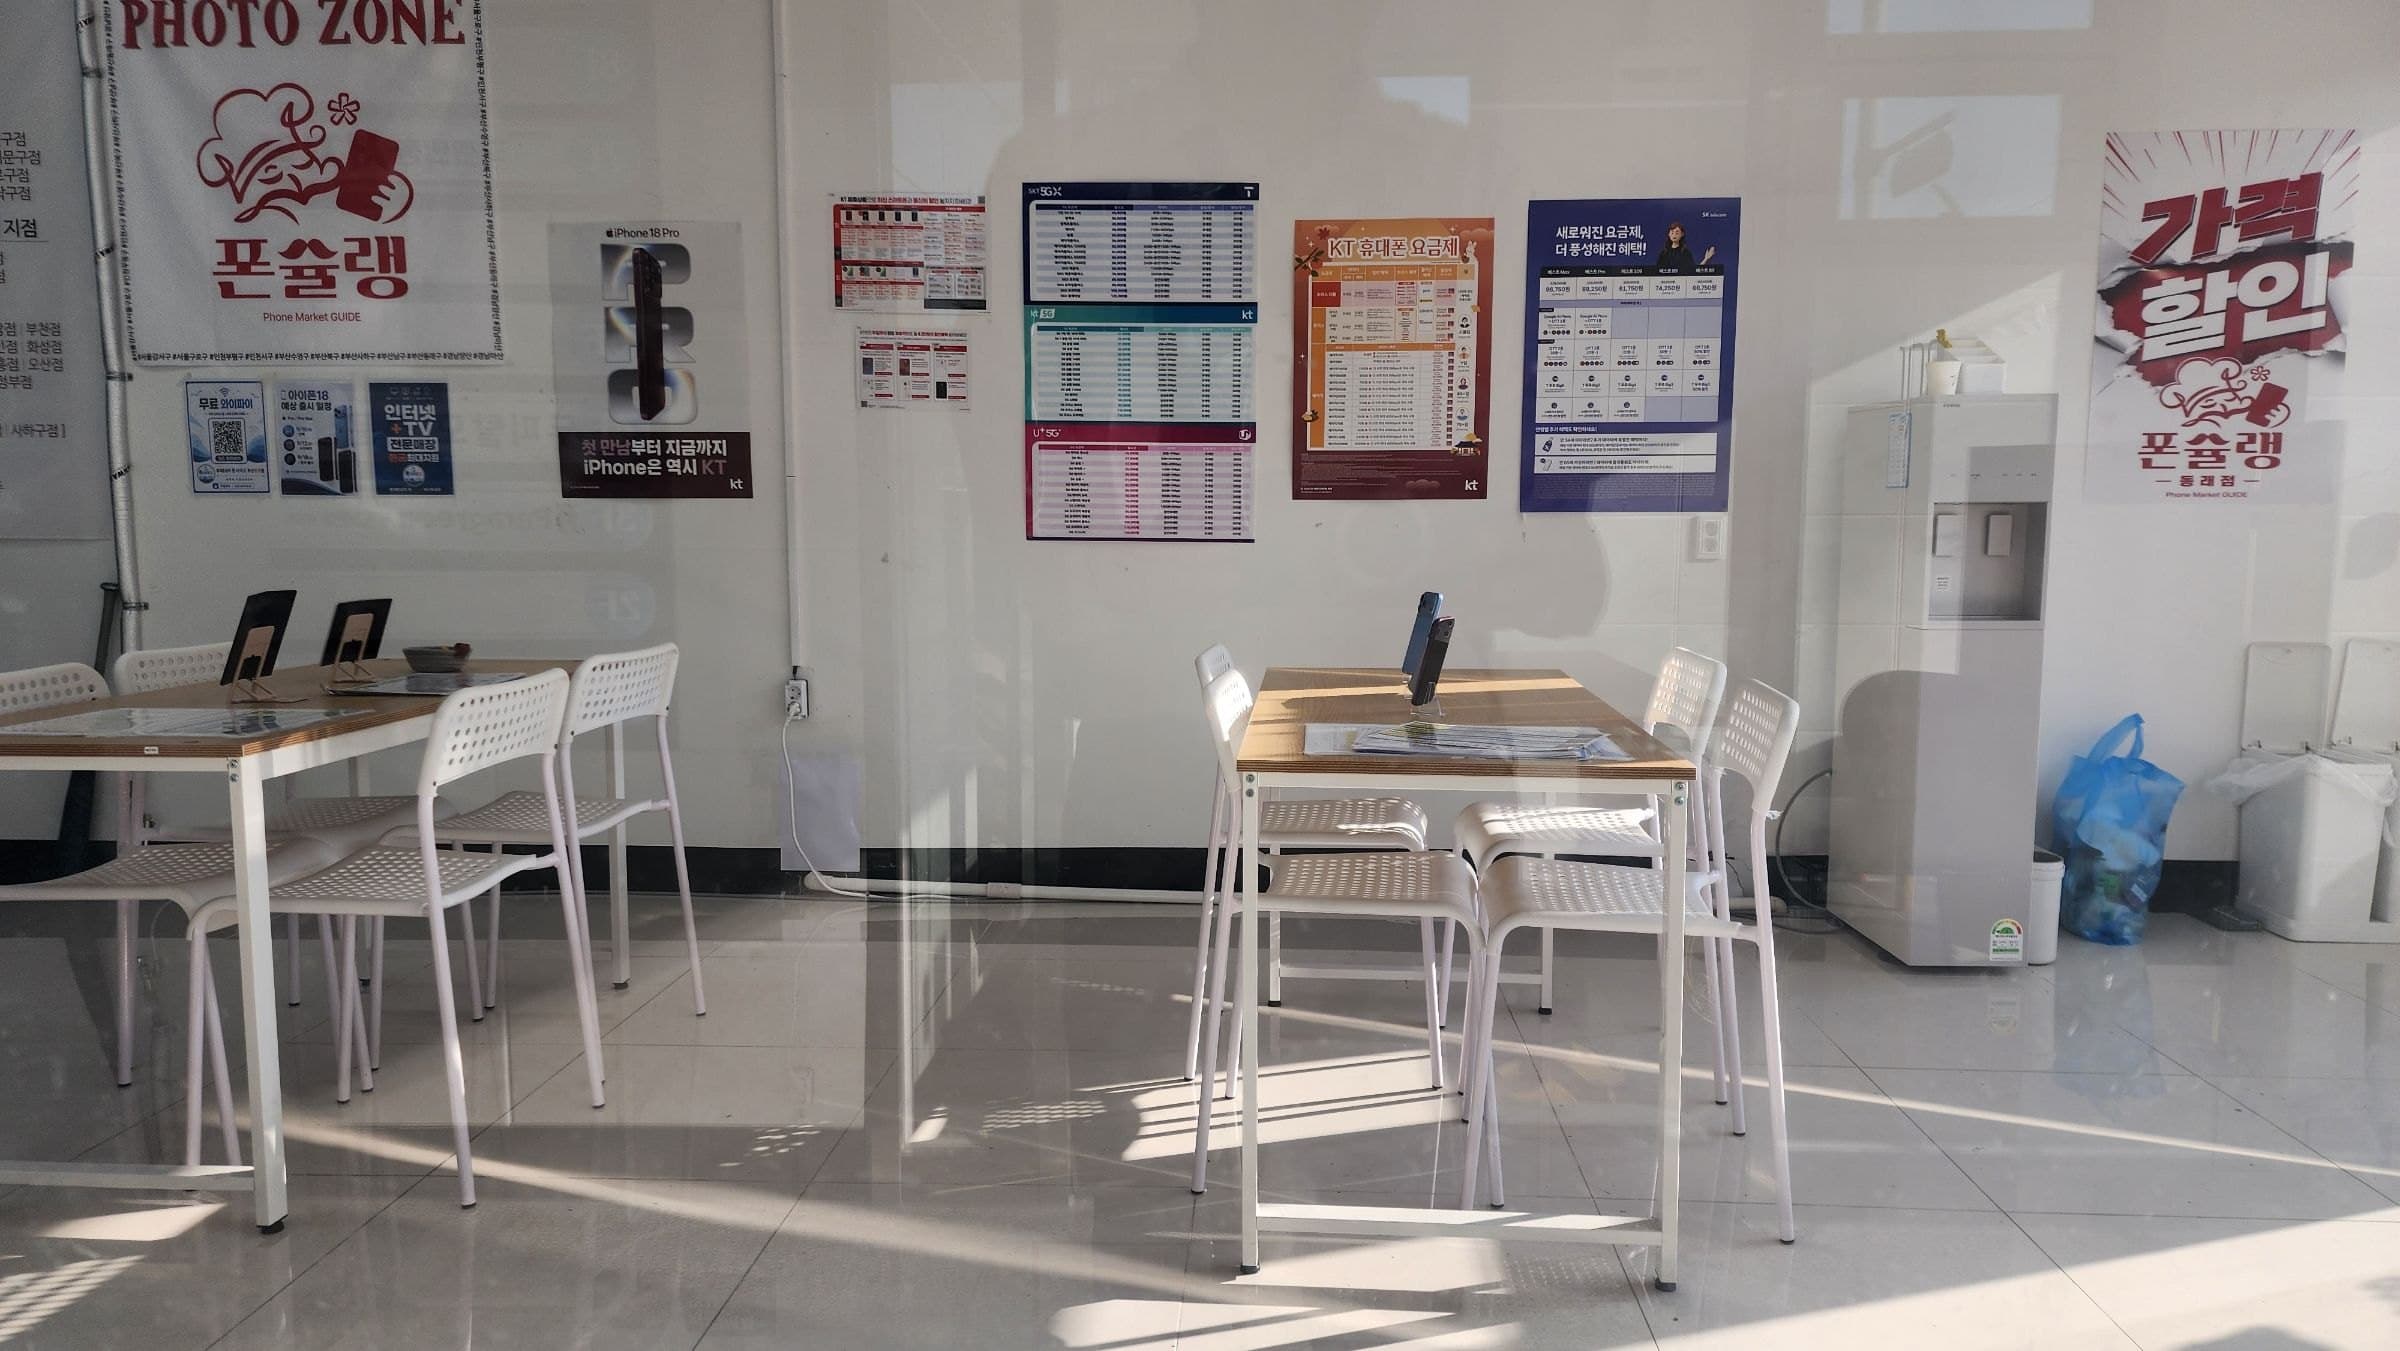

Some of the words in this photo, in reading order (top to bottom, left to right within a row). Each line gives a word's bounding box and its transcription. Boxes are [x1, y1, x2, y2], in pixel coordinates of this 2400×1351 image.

[121, 0, 300, 49] PHOTO
[318, 0, 466, 46] ZONE
[0, 150, 41, 165] 문구점
[0, 168, 29, 183] 구점
[2130, 171, 2324, 264] 가격
[3, 218, 37, 238] 지점
[614, 228, 649, 238] iPhone
[650, 228, 661, 238] 18
[662, 228, 680, 238] Pro
[1556, 225, 1604, 240] 새로워진
[1604, 225, 1644, 240] 요금제,
[1330, 239, 1356, 257] KT
[1359, 238, 1406, 258] 휴대폰
[1412, 237, 1458, 258] 요금제
[1556, 243, 1568, 257] 더
[1568, 243, 1618, 258] 풍성해진
[1618, 242, 1647, 257] 혜택!
[213, 236, 409, 299] 폰슐랭
[1030, 309, 1039, 318] kt
[1041, 309, 1055, 318] 5G
[2140, 251, 2331, 362] 할인
[263, 311, 293, 322] Phone
[295, 311, 327, 322] Market
[329, 311, 362, 322] GUIDE
[1242, 309, 1254, 320] kt
[28, 358, 64, 372] 오산점
[288, 390, 329, 400] 아이폰18
[199, 398, 218, 410] 무료
[220, 399, 253, 409] 와이파이
[281, 402, 297, 411] 예상
[300, 402, 314, 411] 출시
[384, 404, 437, 421] 인터넷
[581, 440, 597, 457] 첫
[600, 440, 662, 457] 만남부터
[665, 440, 728, 457] 지금까지
[2138, 432, 2282, 470] 폰슐랭
[583, 459, 662, 476] iPhone은
[666, 459, 698, 476] 역시
[702, 459, 728, 475] KT
[730, 478, 744, 490] kt
[1464, 480, 1478, 491] kt
